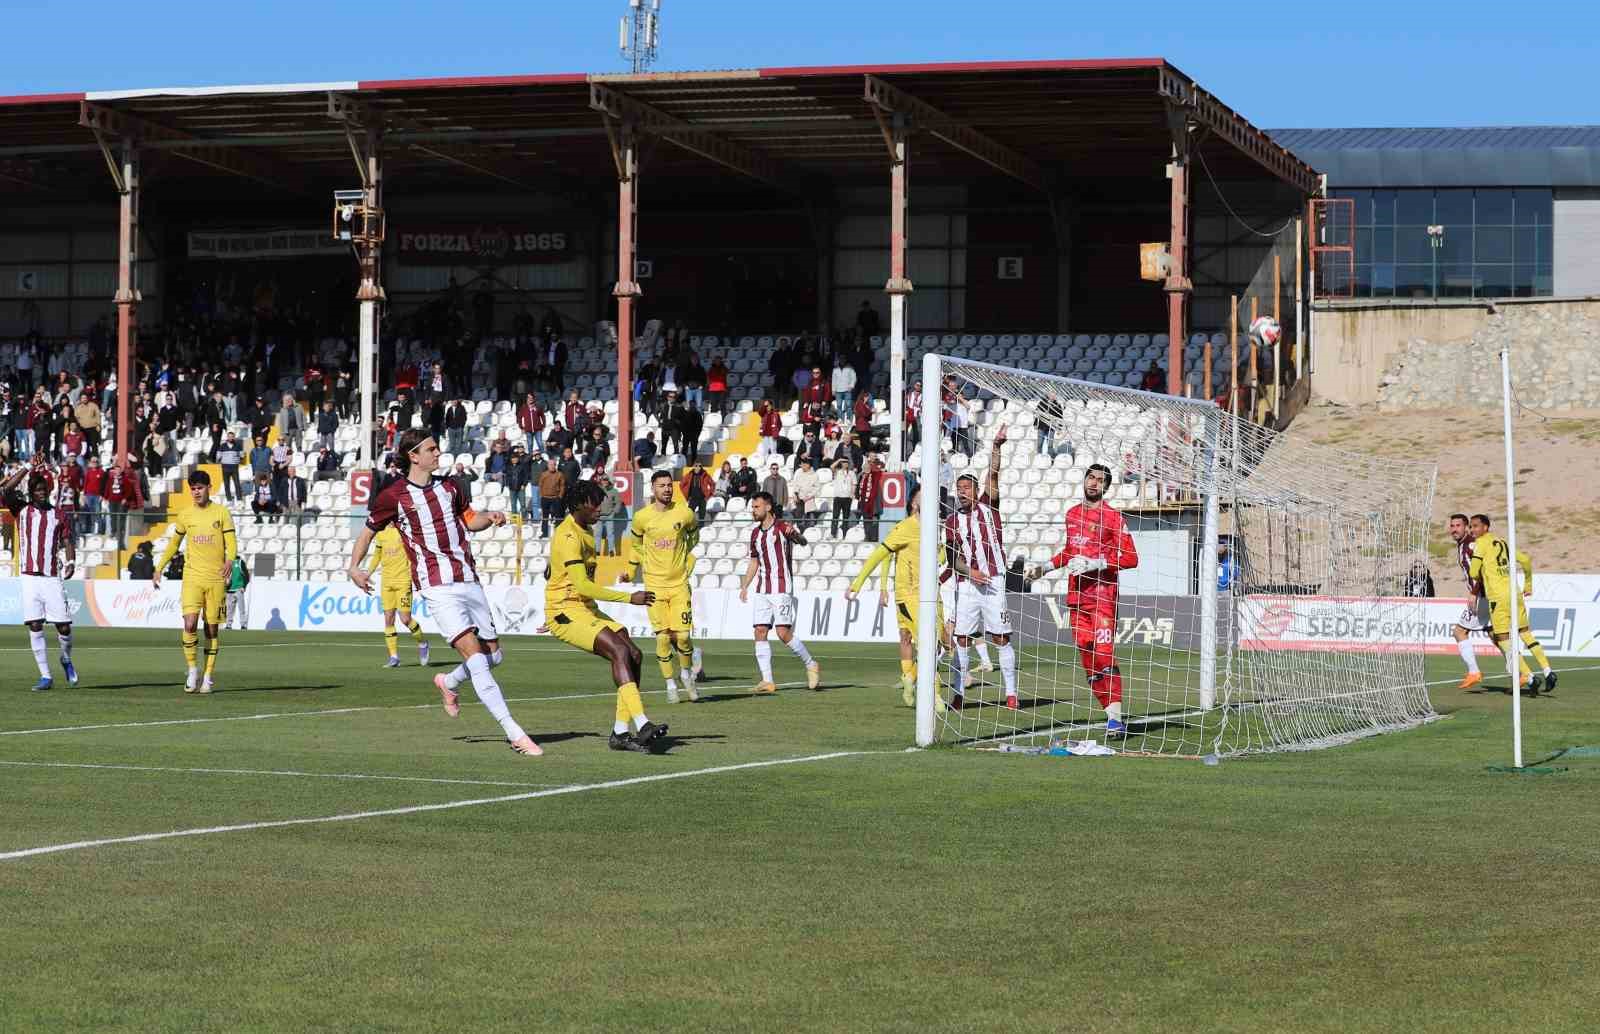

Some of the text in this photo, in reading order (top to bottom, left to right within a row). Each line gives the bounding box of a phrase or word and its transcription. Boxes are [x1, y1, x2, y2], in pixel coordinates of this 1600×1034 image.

[400, 233, 471, 251] FORZA
[1005, 259, 1017, 278] E
[354, 476, 370, 502] S
[779, 604, 790, 616] 27
[1096, 628, 1112, 643] 28
[1308, 617, 1381, 638] SEDEF
